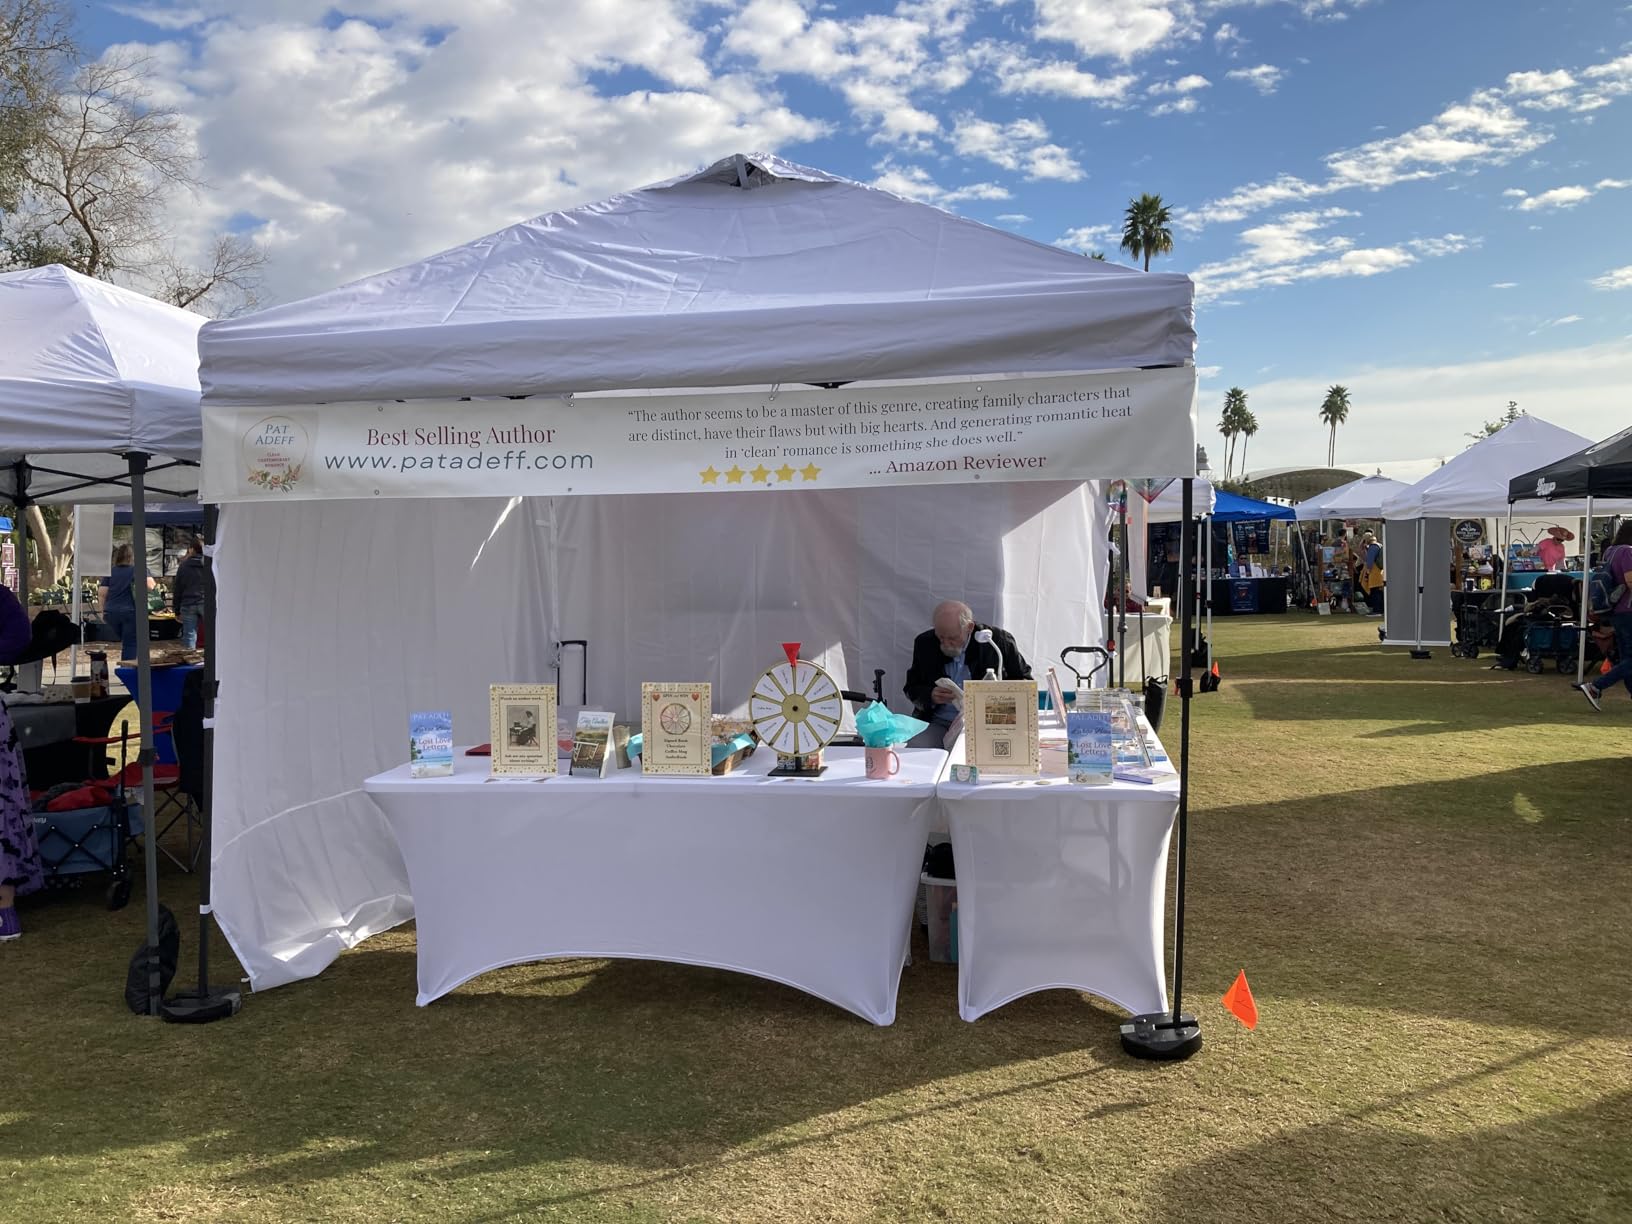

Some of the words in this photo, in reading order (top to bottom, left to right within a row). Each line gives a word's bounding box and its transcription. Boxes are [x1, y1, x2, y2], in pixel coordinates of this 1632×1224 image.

[660, 408, 702, 421] author
[704, 408, 743, 420] seems
[746, 407, 759, 419] to
[762, 406, 777, 418] be
[780, 407, 787, 417] a
[791, 405, 835, 417] master
[838, 402, 852, 415] of
[854, 401, 878, 414] this
[880, 402, 922, 415] genre,
[925, 397, 979, 410] creating
[983, 393, 1024, 408] family
[1027, 390, 1100, 405] characters
[1104, 387, 1131, 399] that
[265, 424, 290, 434] PAT
[628, 431, 648, 441] are
[704, 427, 733, 440] have
[735, 426, 767, 438] their
[769, 425, 801, 438] flaws
[805, 424, 826, 436] but
[828, 422, 856, 435] with
[860, 421, 880, 435] big
[883, 419, 927, 433] hearts.
[930, 417, 956, 430] And
[960, 414, 1033, 430] generating
[1036, 408, 1099, 423] romantic
[1101, 405, 1133, 418] heat
[255, 435, 295, 445] ADEFF
[367, 428, 409, 446] Best
[415, 426, 482, 448] Selling
[486, 424, 556, 444] Author
[725, 447, 737, 458] in
[783, 446, 838, 457] romance
[841, 442, 852, 454] is
[855, 440, 923, 454] something
[925, 437, 949, 448] she
[952, 435, 982, 446] does
[325, 450, 593, 472] www.patadeff.com
[885, 460, 957, 473] Amazon
[963, 454, 1047, 470] Reviewer
[1081, 748, 1107, 756] Letters
[1094, 741, 1111, 749] Love
